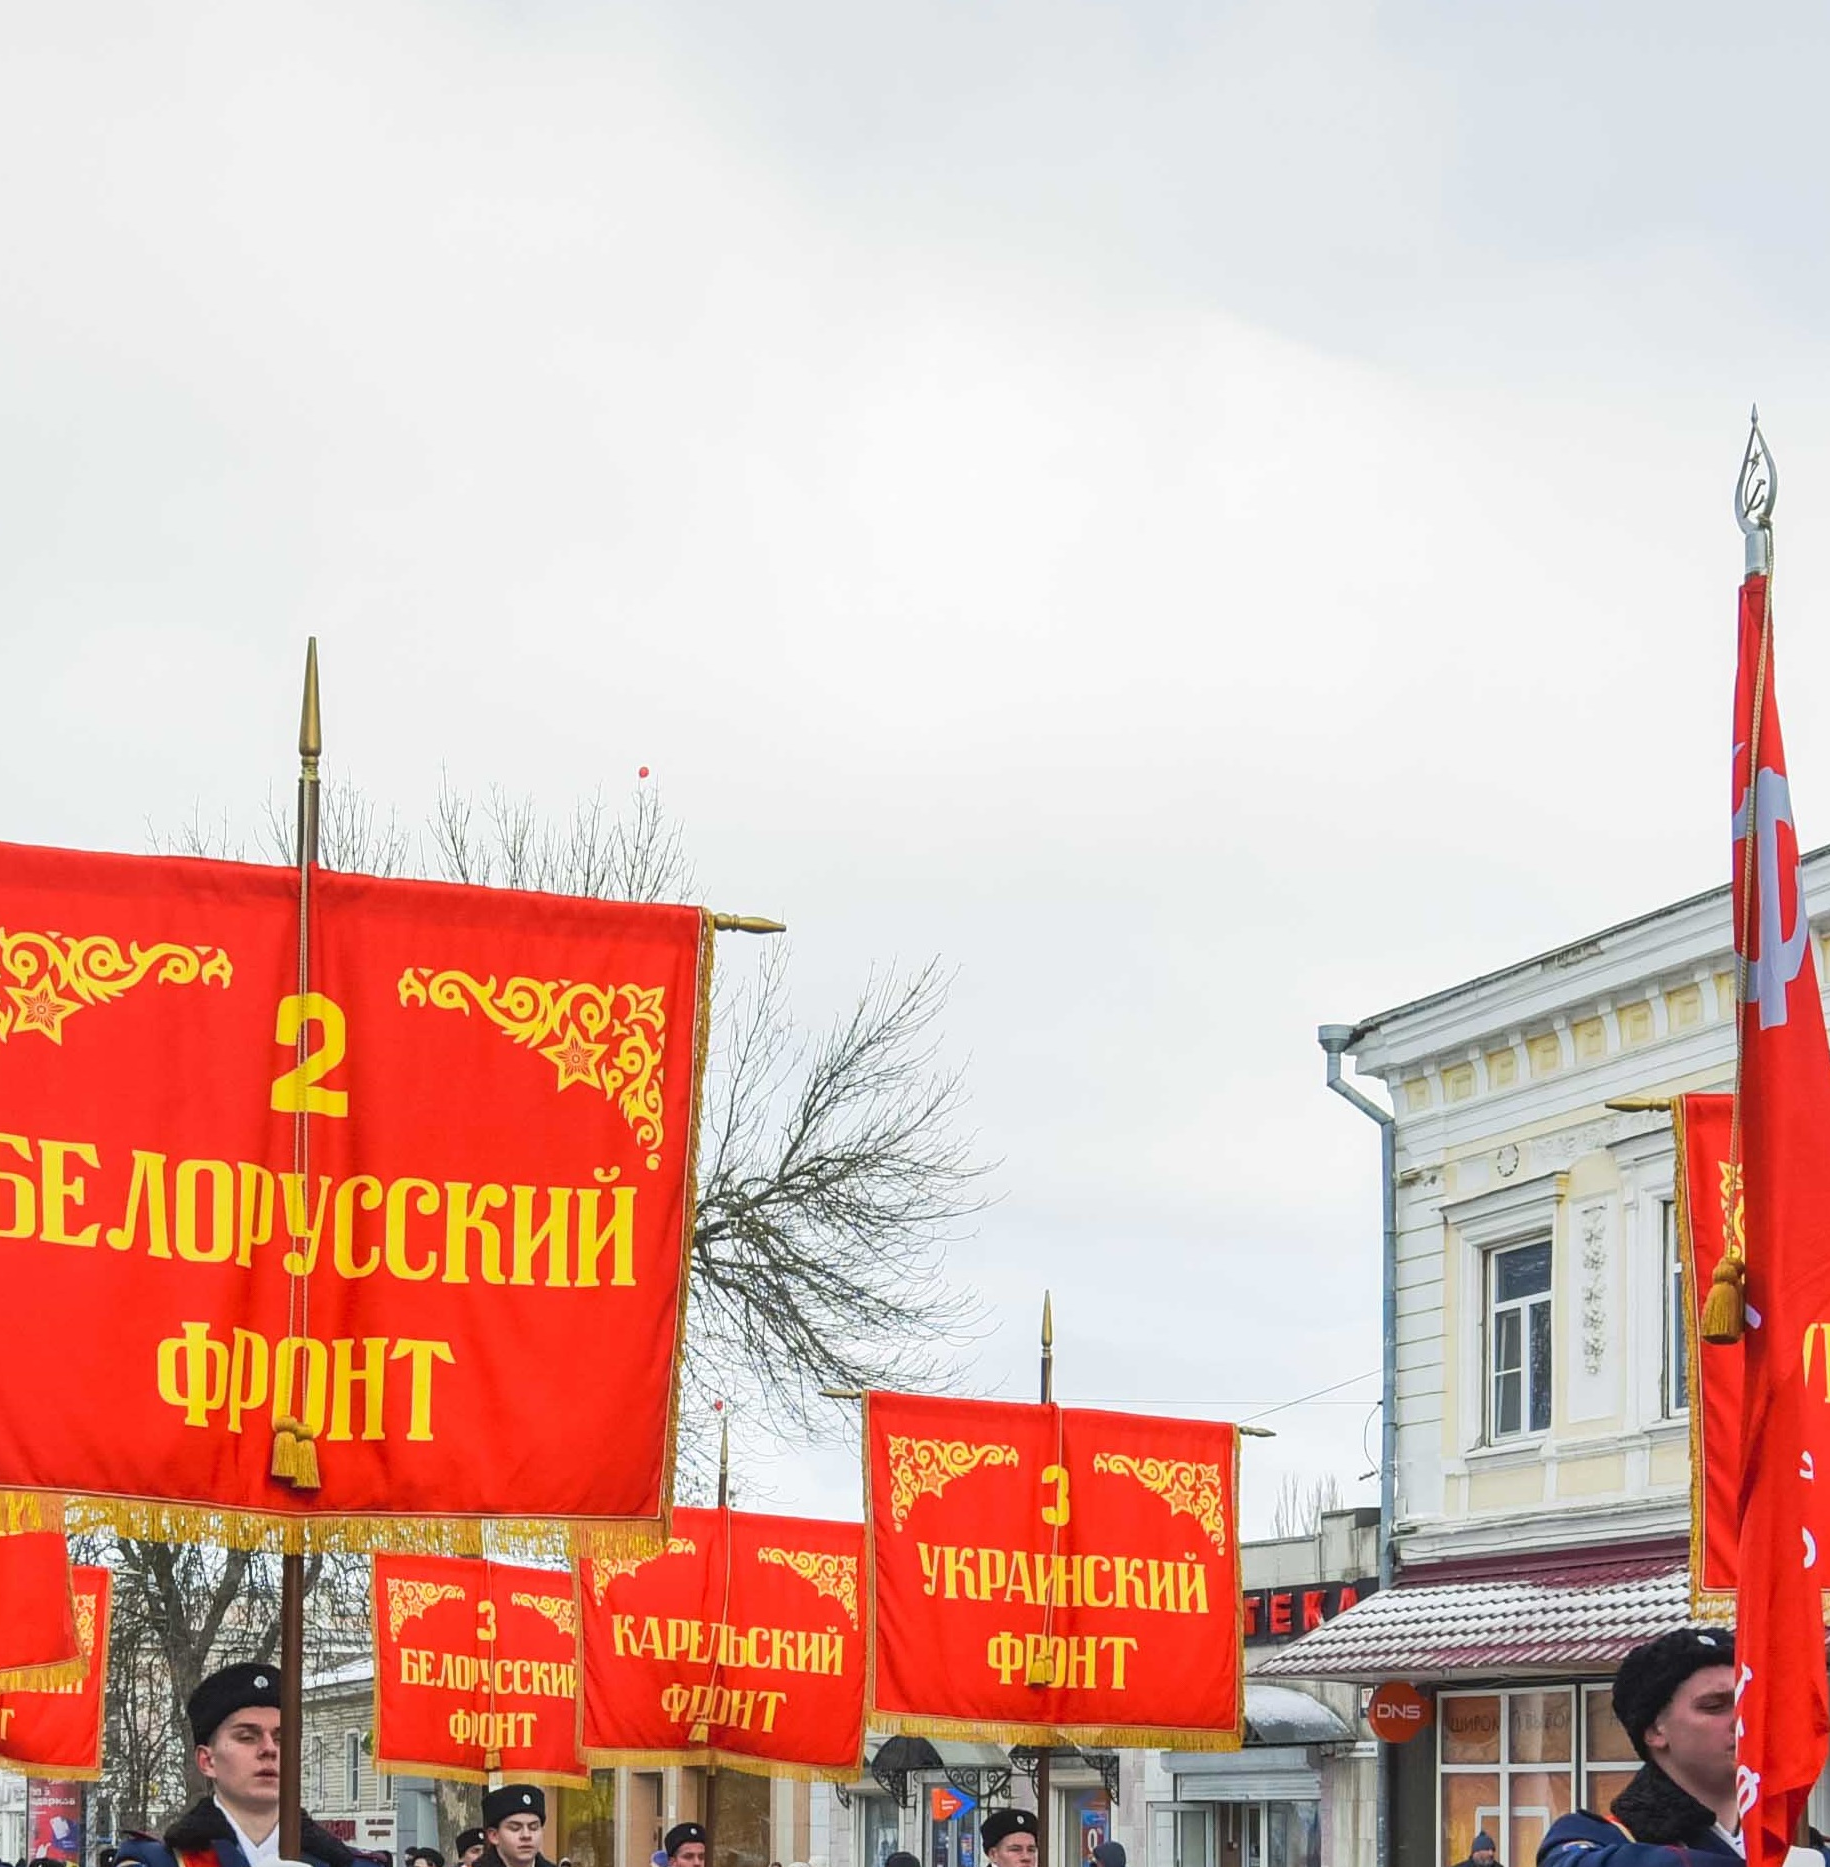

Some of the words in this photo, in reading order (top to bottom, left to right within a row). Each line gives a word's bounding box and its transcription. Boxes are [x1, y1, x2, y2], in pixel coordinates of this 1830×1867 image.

[270, 992, 349, 1118] 2
[156, 1320, 456, 1443] ФРОНТ
[1041, 1464, 1070, 1527] 3
[916, 1541, 1210, 1614] УКРАИНСКИЙ
[476, 1599, 497, 1641] 3
[1244, 1586, 1359, 1636] ТЕКА
[612, 1613, 845, 1677] КАРЕЛЬСКИЙ
[986, 1630, 1139, 1691] ФРОНТ
[448, 1707, 538, 1749] ФРОНТ
[661, 1682, 786, 1734] ФРОНТ
[1376, 1702, 1421, 1720] DNS
